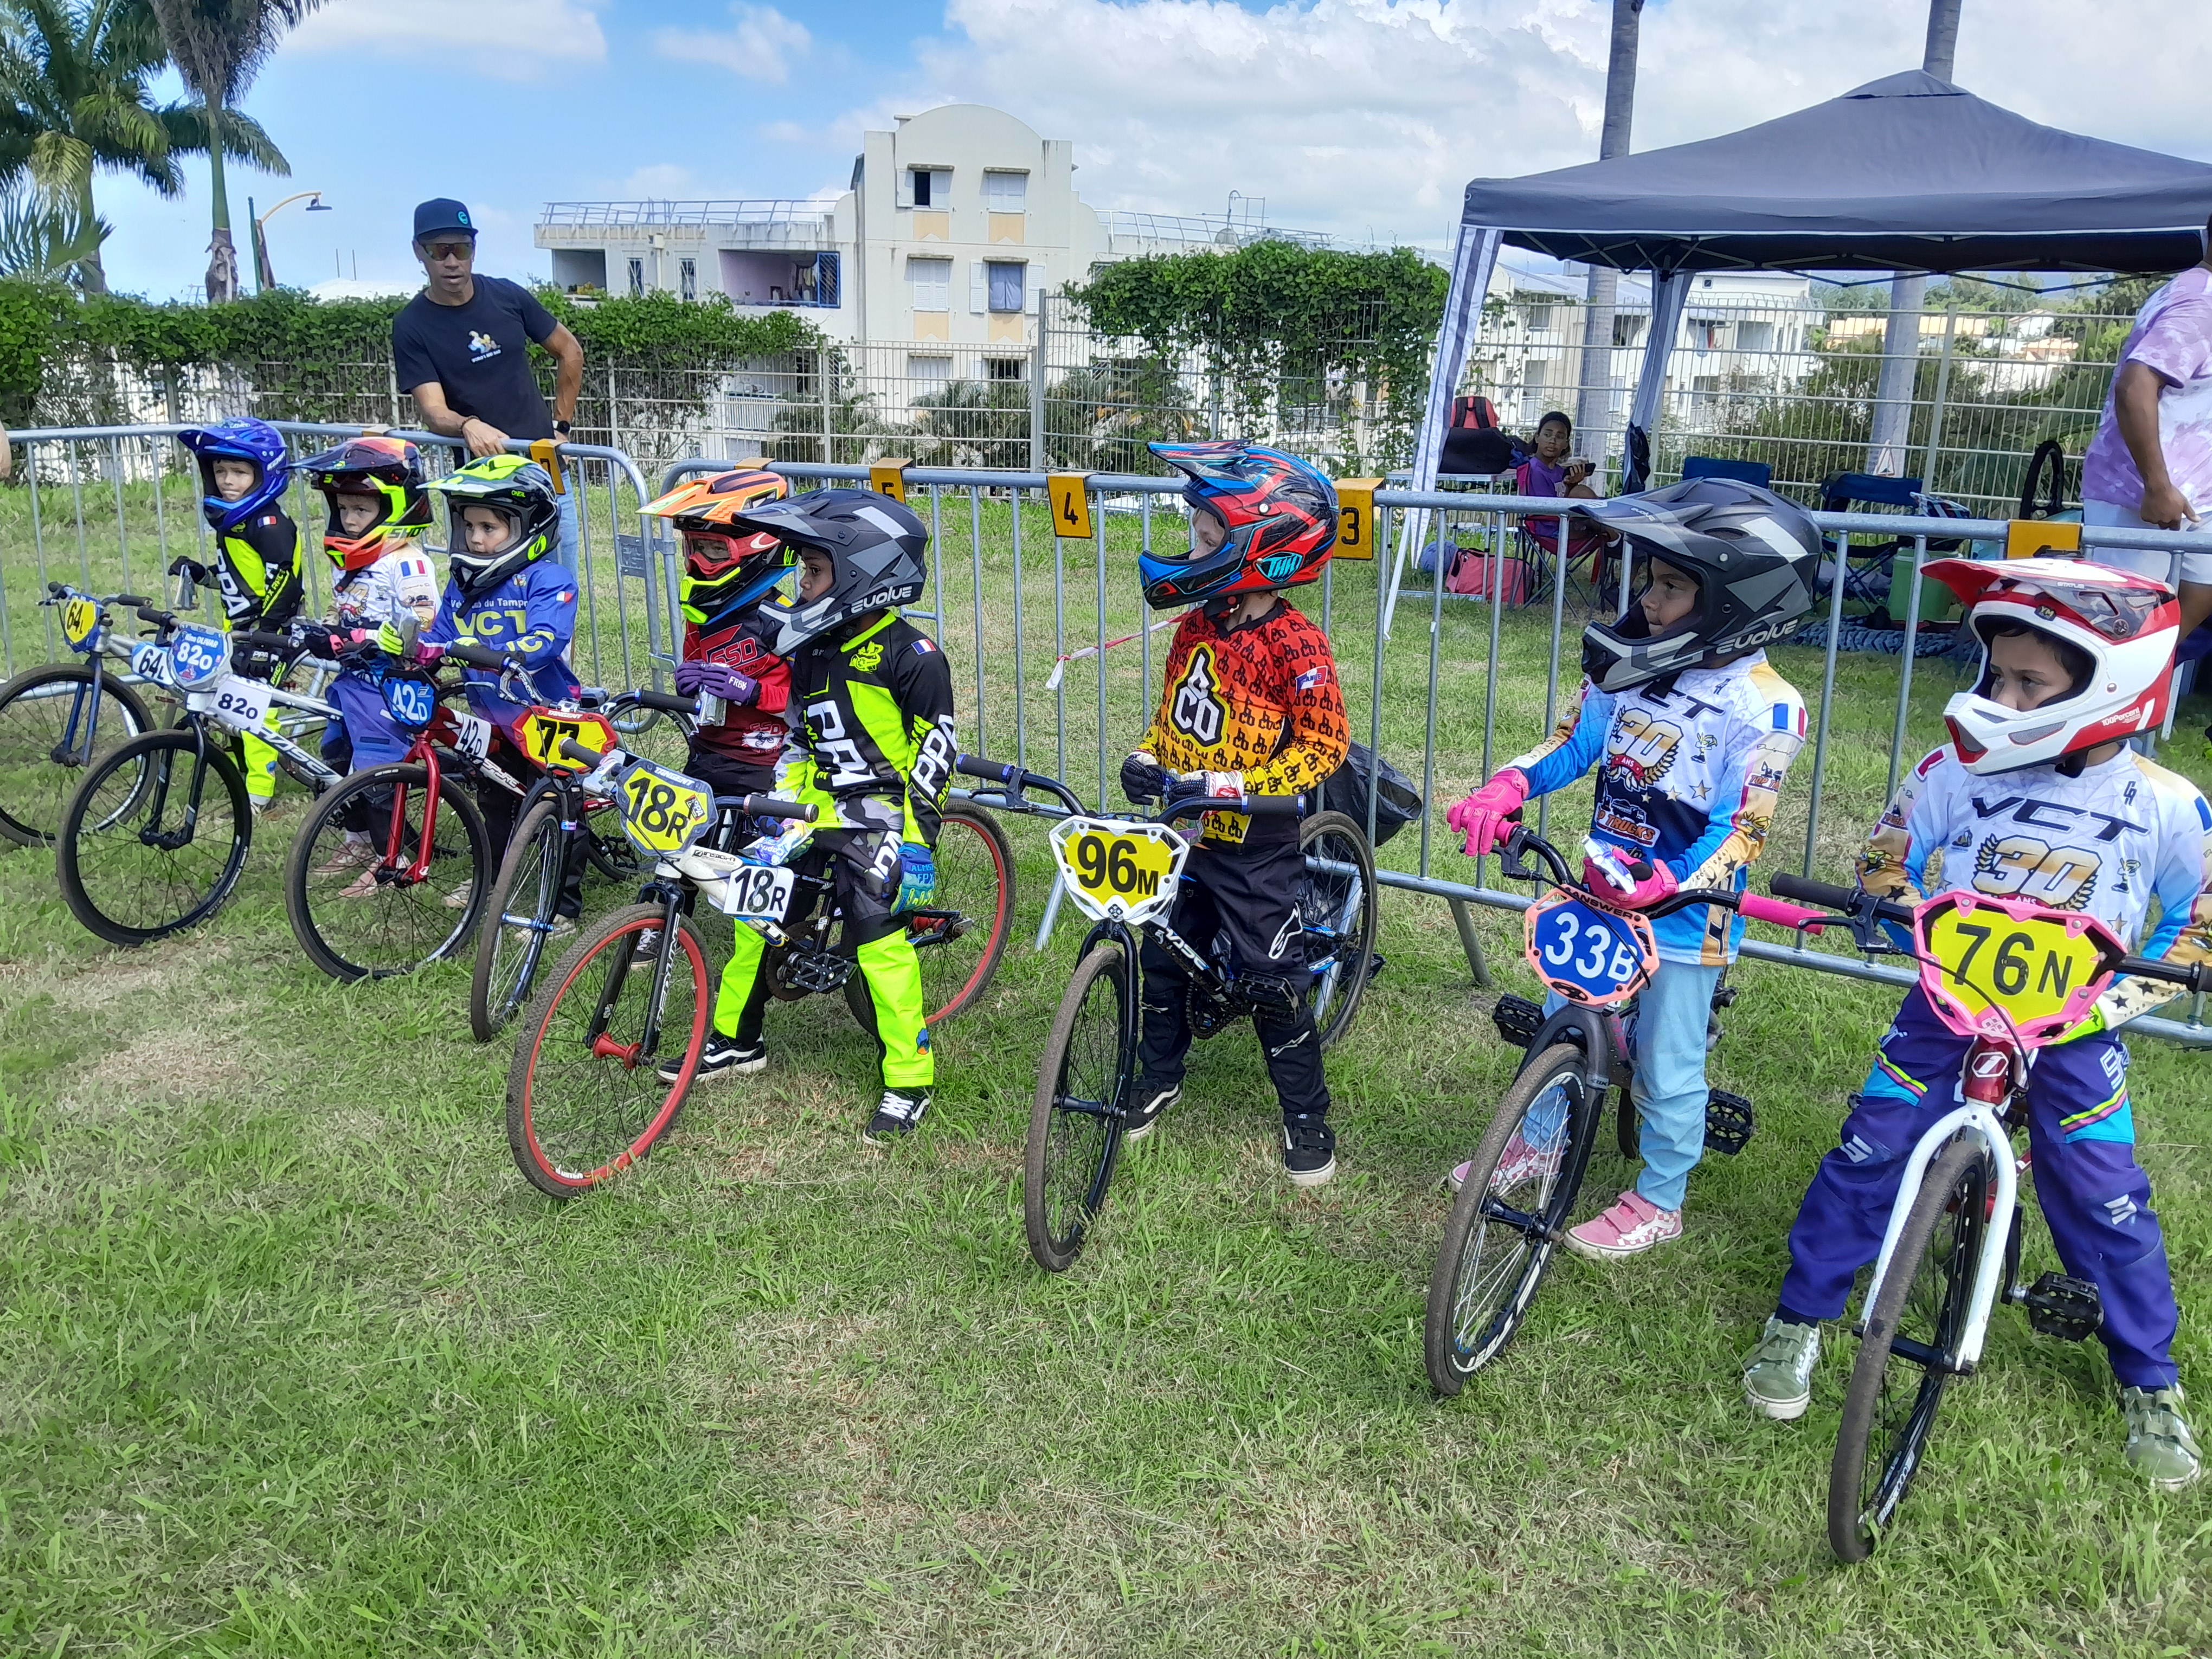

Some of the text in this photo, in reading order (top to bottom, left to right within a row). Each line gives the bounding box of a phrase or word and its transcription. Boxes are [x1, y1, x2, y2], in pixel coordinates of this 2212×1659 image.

[1063, 491, 1078, 524] 4
[1341, 507, 1359, 545] 3
[452, 610, 526, 636] VCT
[392, 683, 429, 722] 42D
[459, 718, 483, 756] 42D
[1607, 707, 1684, 769] 30
[653, 767, 695, 786] TANGENT
[628, 777, 690, 844] 18R
[1605, 813, 1656, 840] TRUCKS
[1971, 796, 2150, 843] VCT
[1077, 835, 1159, 897] 96M
[1971, 834, 2104, 907] 30
[734, 867, 787, 914] 18R
[1574, 891, 1633, 920] ANSWER
[1545, 911, 1638, 982] 33B
[1954, 922, 2073, 999] 76N
